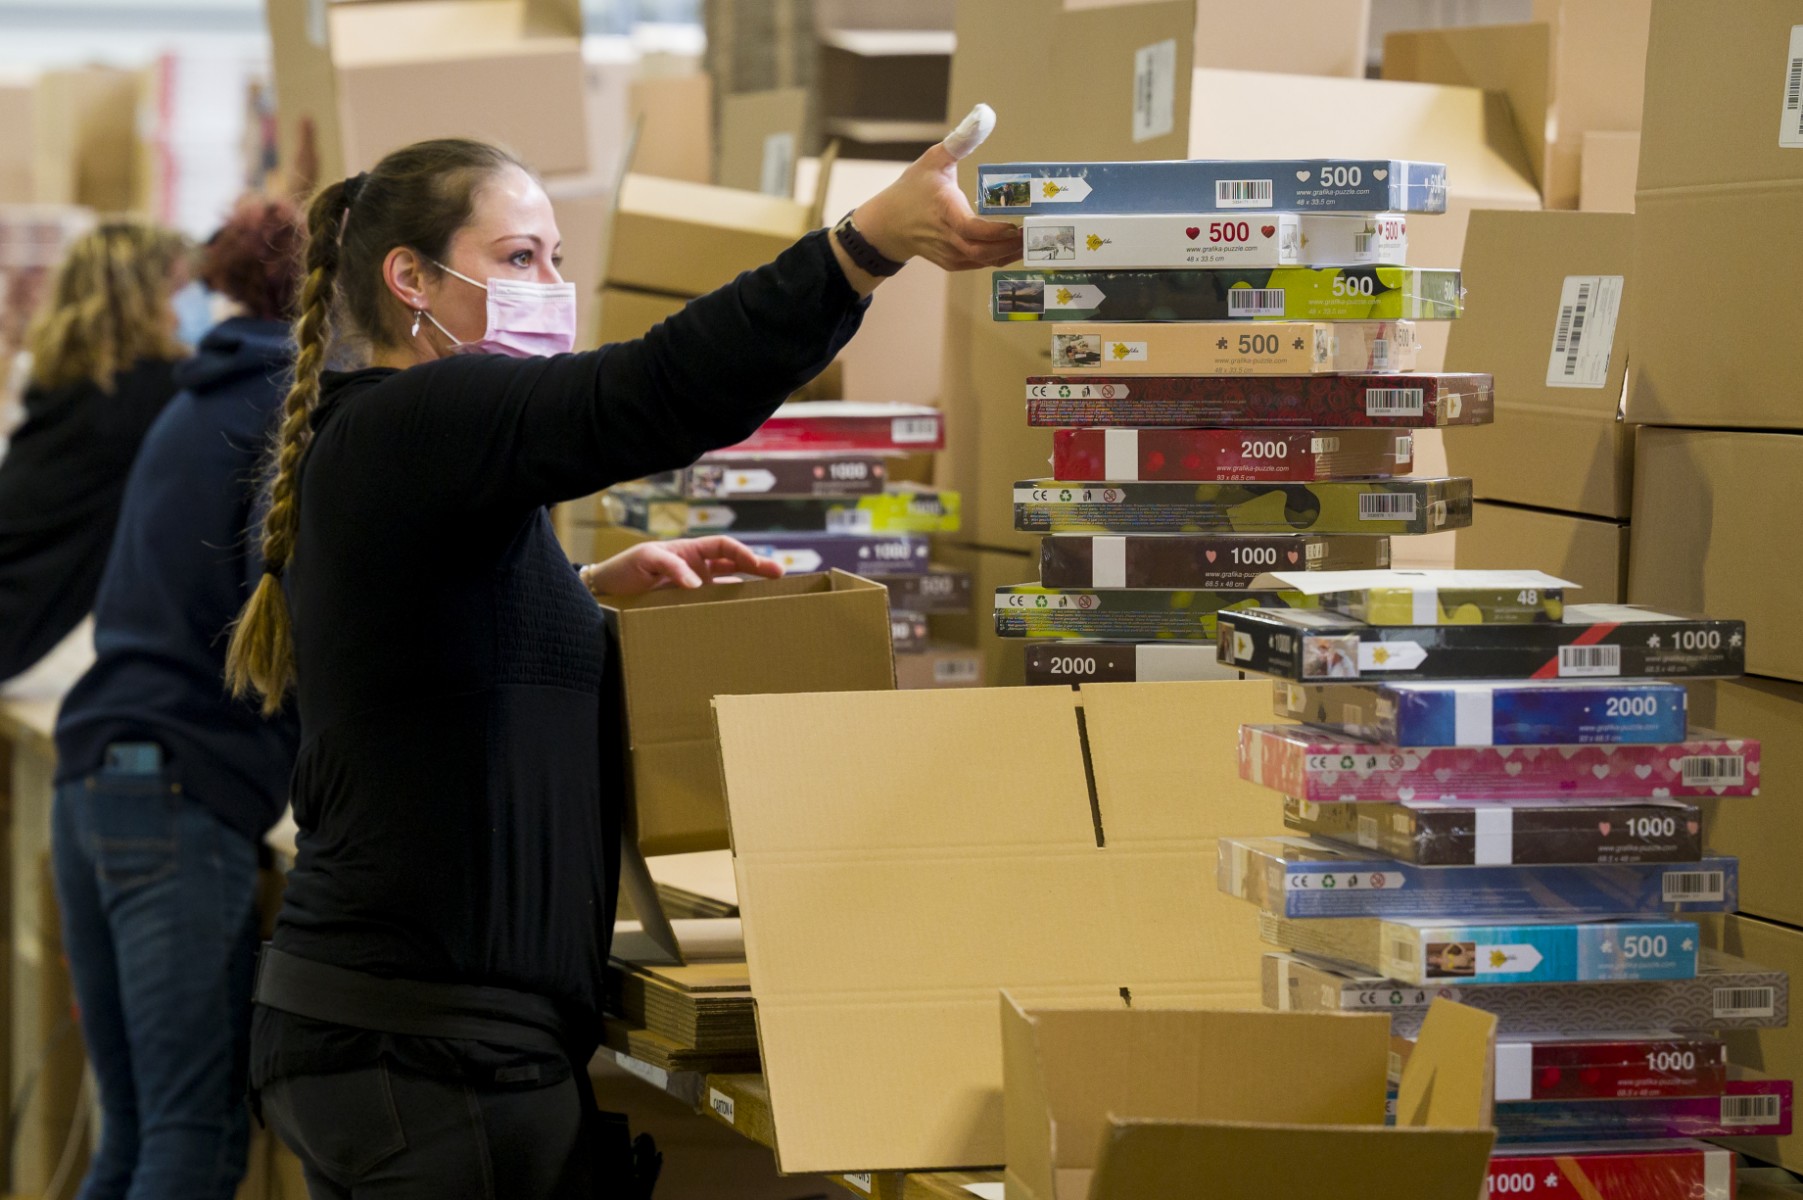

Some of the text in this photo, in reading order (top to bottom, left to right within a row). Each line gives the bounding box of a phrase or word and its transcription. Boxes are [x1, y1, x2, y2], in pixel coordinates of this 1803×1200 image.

[1320, 166, 1361, 187] 500
[1296, 189, 1370, 197] www.grafika-puzzle.com
[1209, 221, 1250, 243] 500
[1385, 221, 1398, 240] 500
[1332, 276, 1373, 297] 500
[1238, 334, 1279, 355] 500
[1032, 386, 1047, 397] CE
[1241, 441, 1288, 458] 2000
[1216, 465, 1290, 473] www.grafika-puzzle.com
[1032, 490, 1047, 501] CE
[1231, 547, 1277, 565] 1000
[1205, 580, 1219, 588] 68.5
[1009, 595, 1024, 606] CE
[1516, 589, 1538, 605] 48
[1671, 630, 1721, 650] 1000
[1050, 656, 1096, 675] 2000
[1606, 696, 1657, 716] 2000
[1310, 756, 1327, 769] CE
[1625, 817, 1675, 837] 1000
[1291, 875, 1308, 888] CE
[1624, 935, 1668, 958] 500
[1360, 992, 1376, 1004] CE
[1645, 1051, 1695, 1071] 1000
[714, 1098, 730, 1116] CARTON
[1487, 1172, 1535, 1193] 1000
